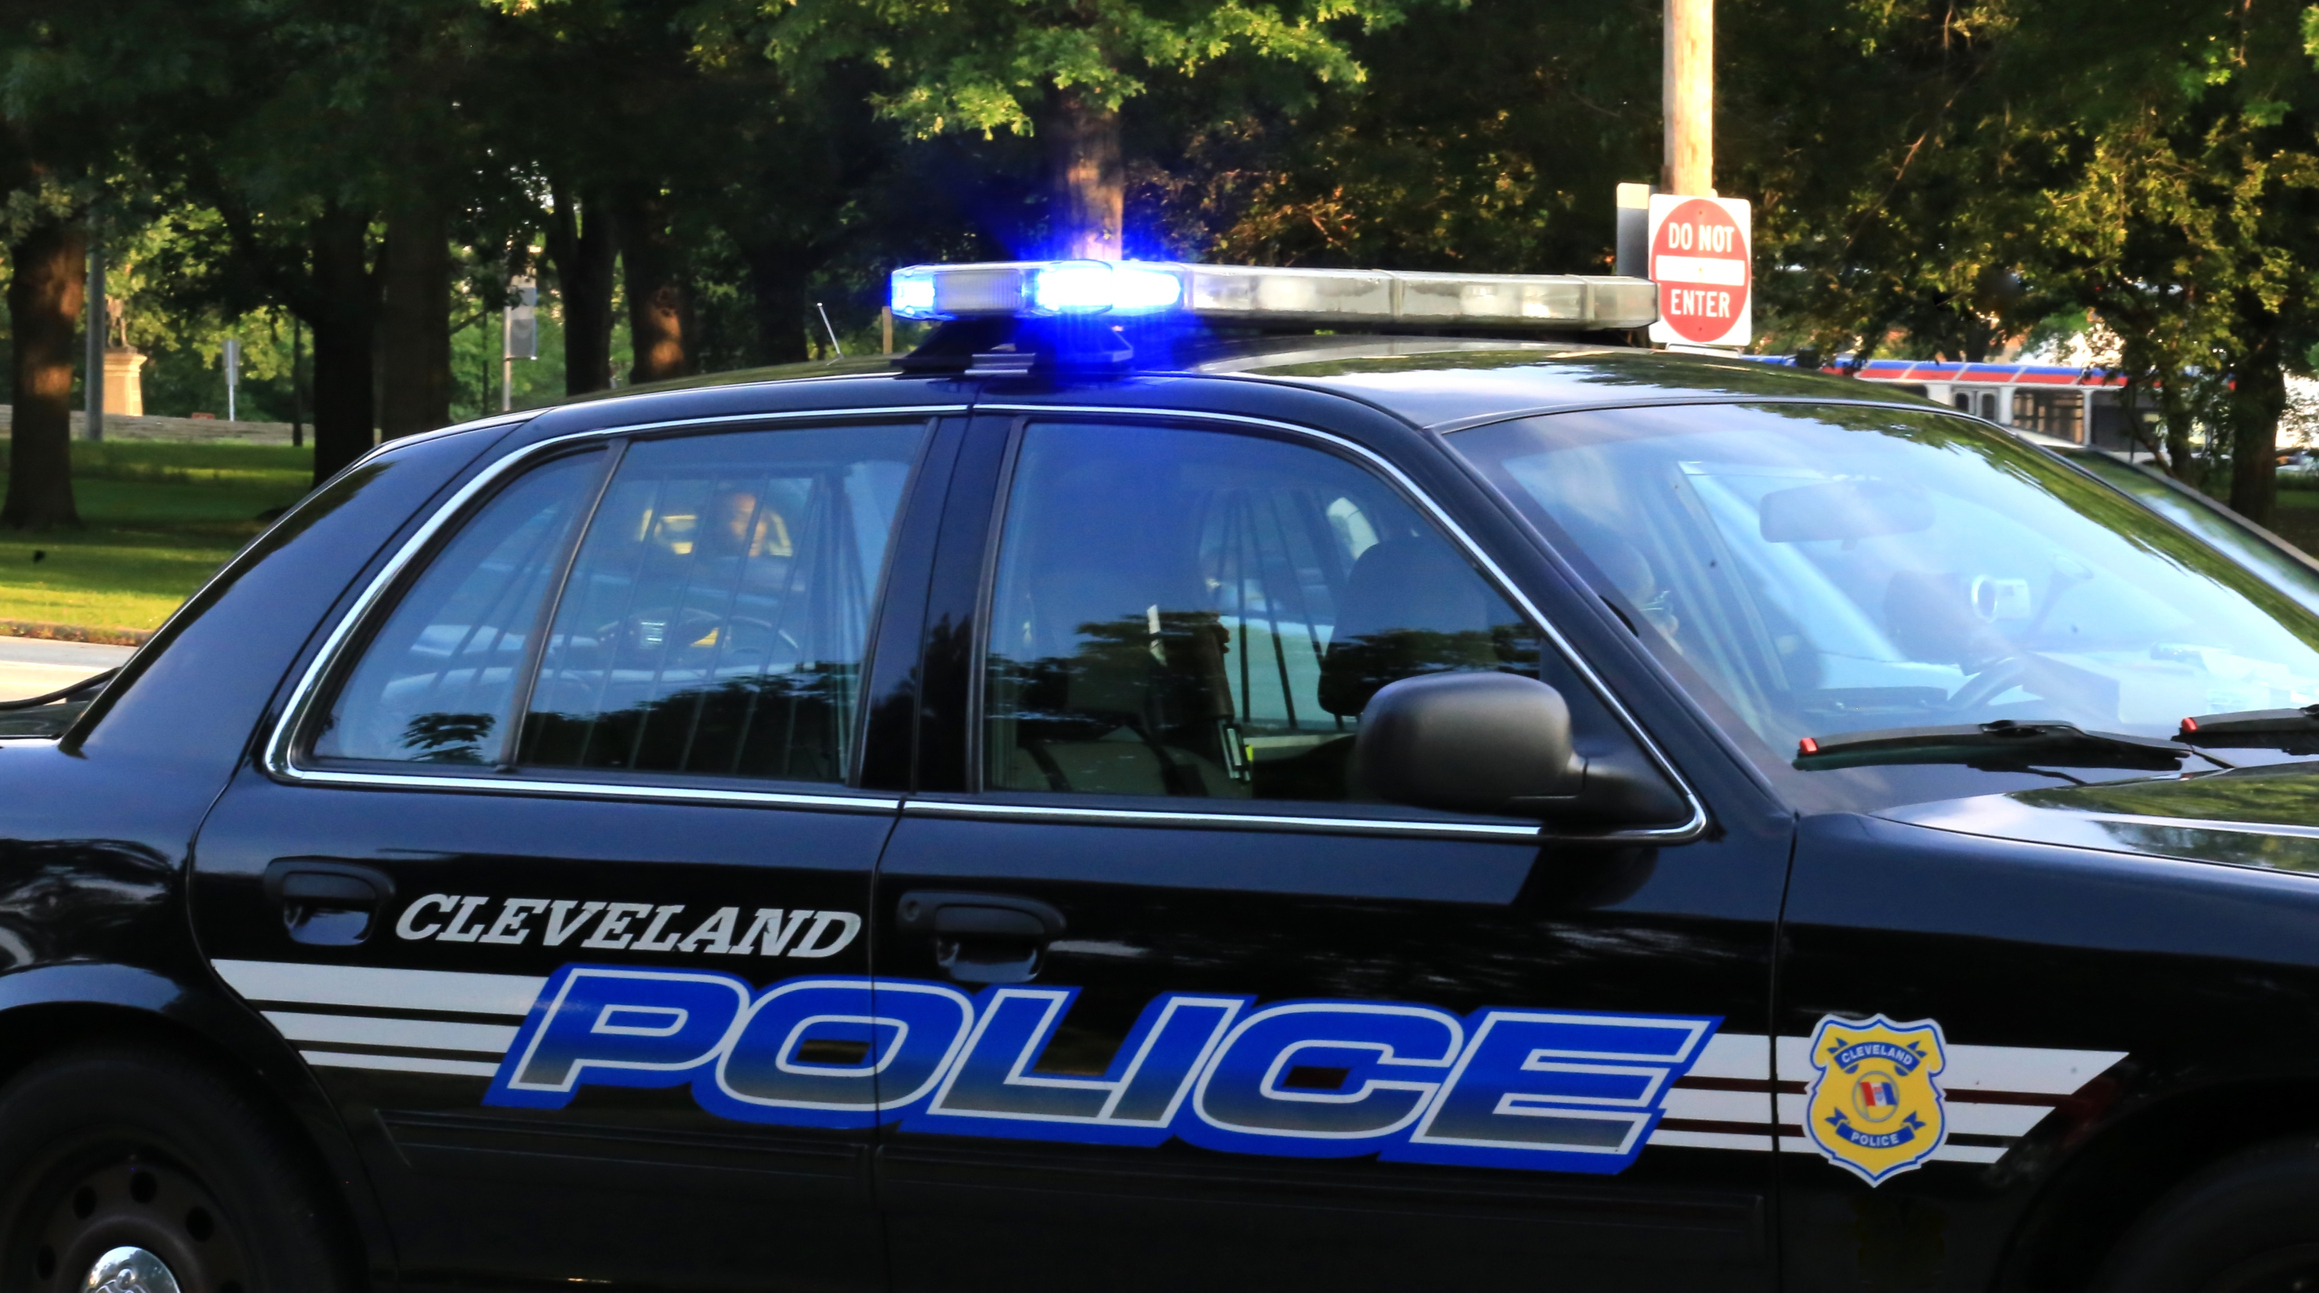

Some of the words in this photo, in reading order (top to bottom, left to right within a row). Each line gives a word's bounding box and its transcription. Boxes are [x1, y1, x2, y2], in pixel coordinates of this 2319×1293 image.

[1668, 222, 1693, 250] DO
[1699, 225, 1734, 252] NOT
[1671, 289, 1730, 318] ENTER
[396, 893, 862, 959] CLEVELAND
[488, 967, 1720, 1172] POLICE
[1841, 1044, 1913, 1066] CLEVELAND
[1851, 1131, 1899, 1146] POLICE
